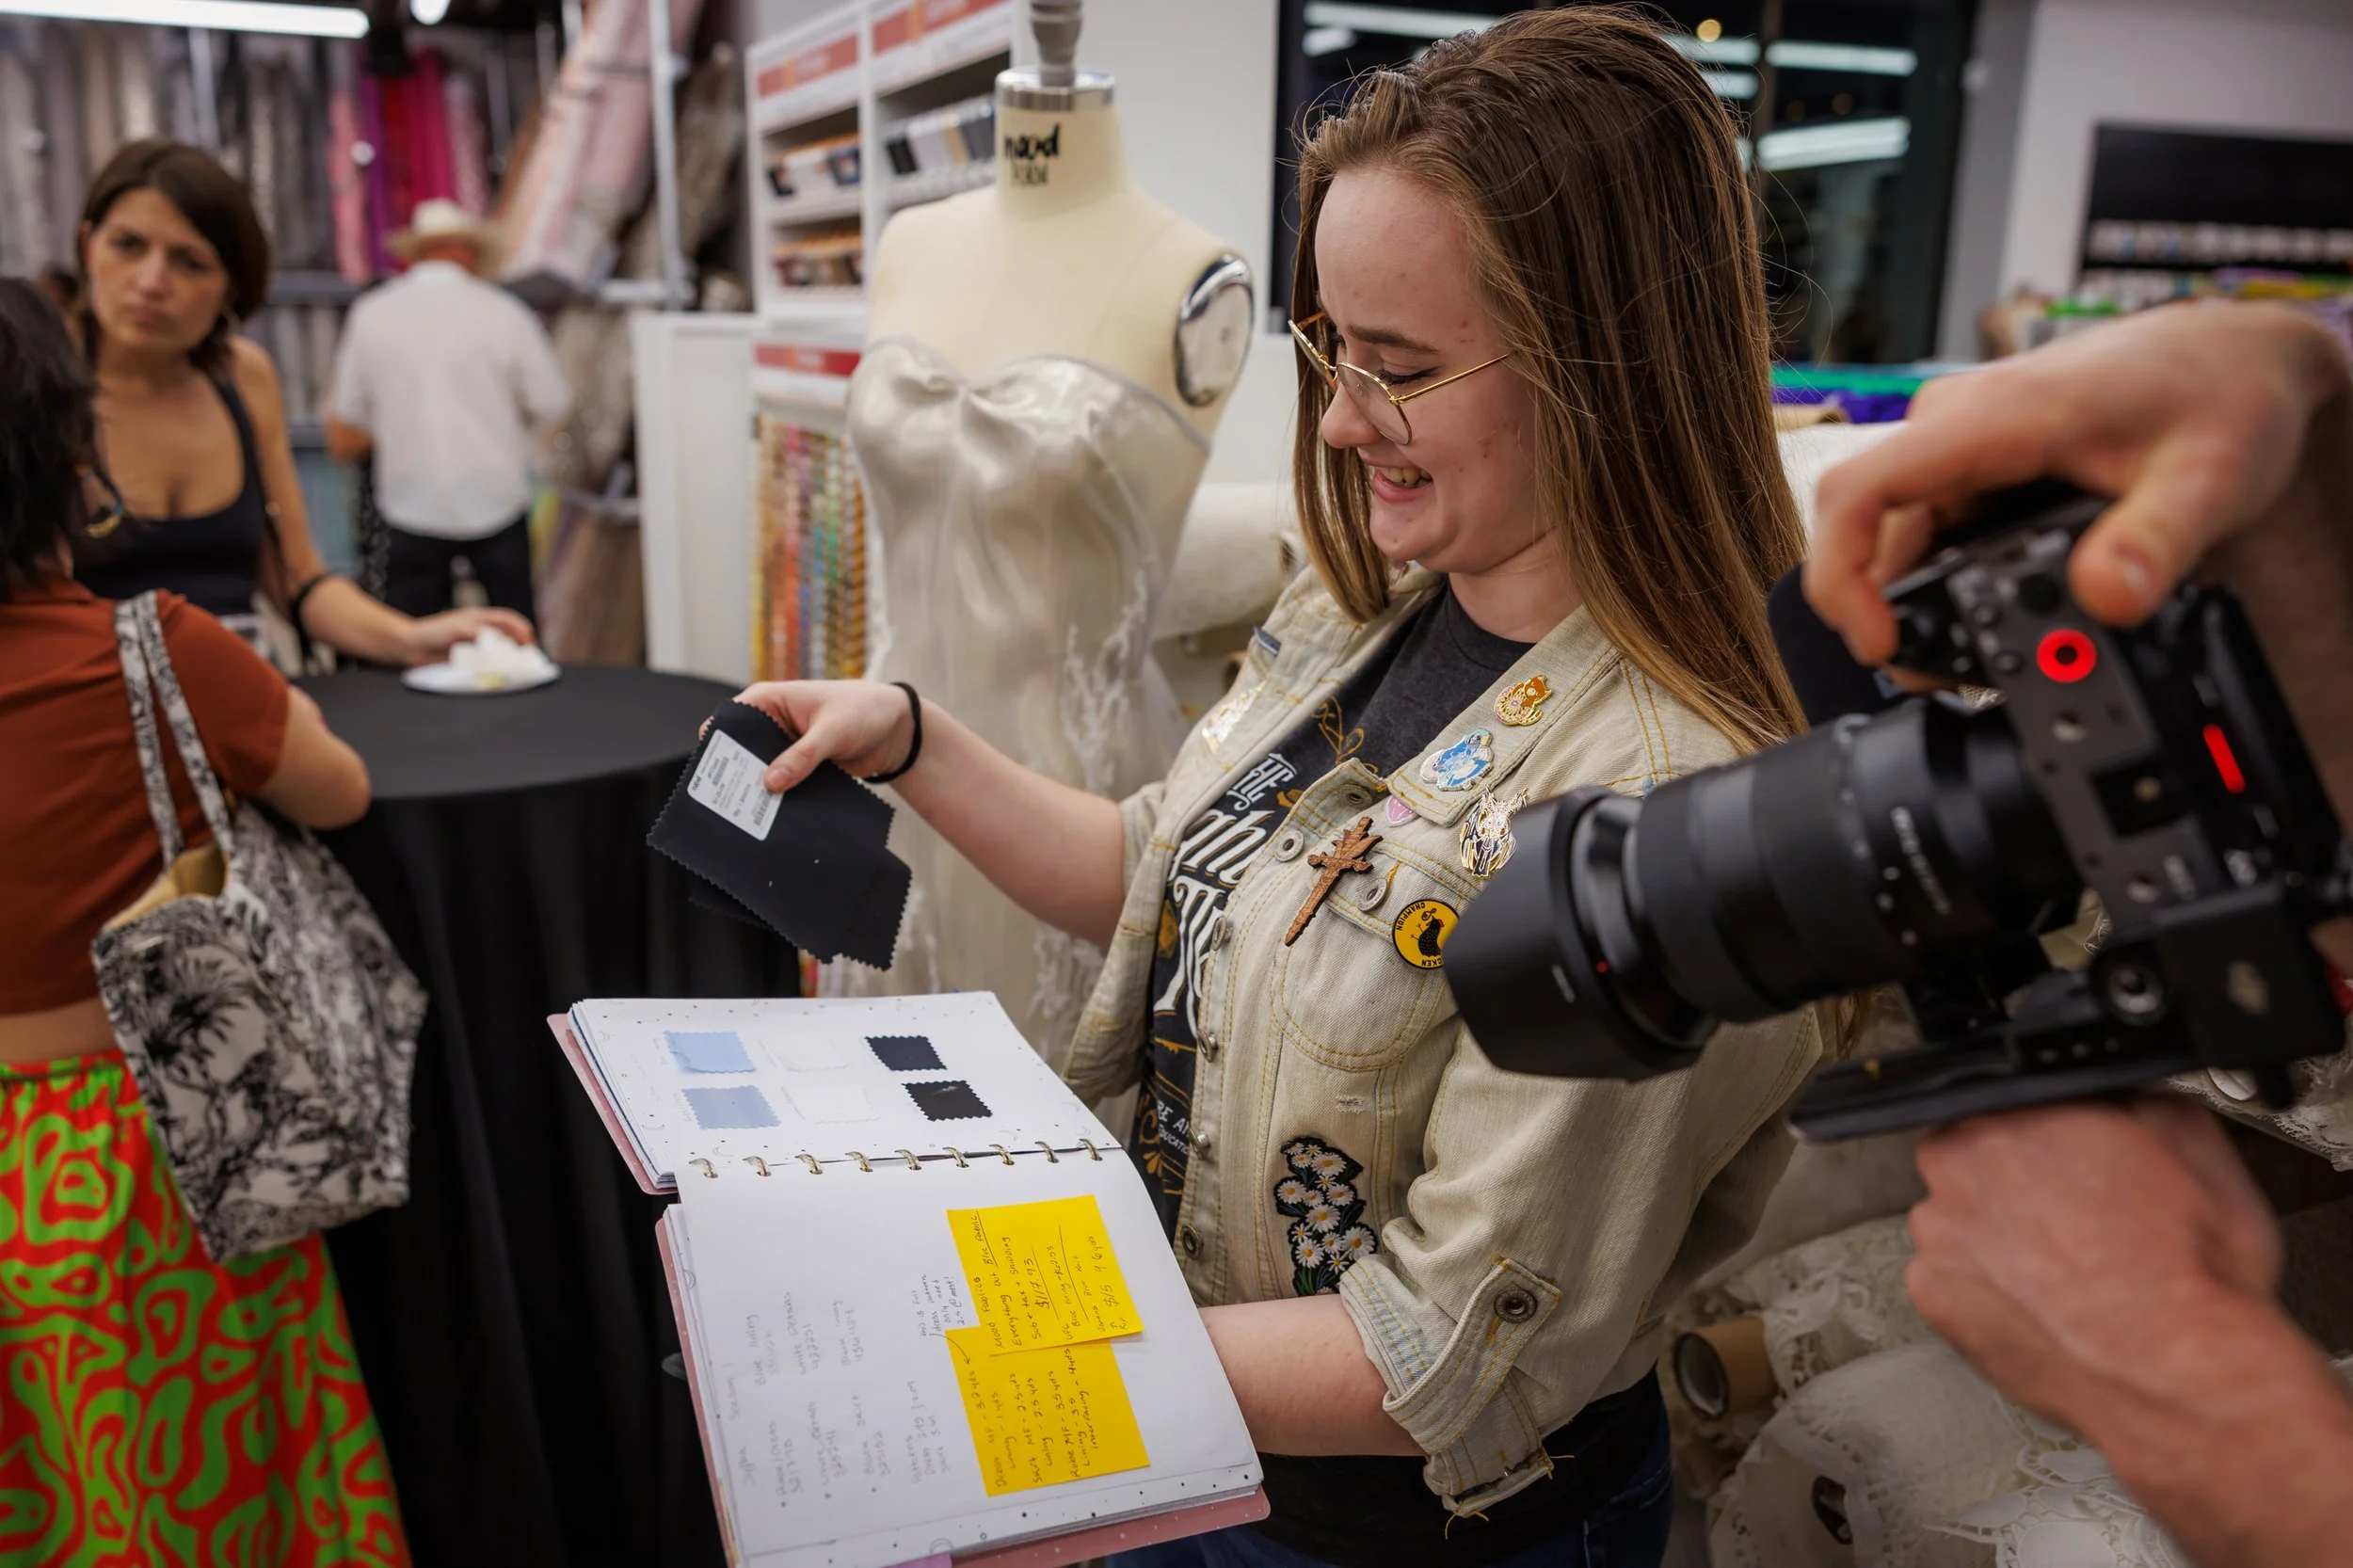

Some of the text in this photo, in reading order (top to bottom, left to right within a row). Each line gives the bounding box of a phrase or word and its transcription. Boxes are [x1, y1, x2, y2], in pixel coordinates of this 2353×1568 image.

[1397, 903, 1426, 931] CHAMPION
[982, 1245, 993, 1265] Blue
[990, 1272, 1001, 1287] but
[1019, 1290, 1030, 1307] tax
[932, 1311, 941, 1332] dress
[941, 1305, 951, 1323] only
[1000, 1294, 1022, 1346] Everything
[1069, 1310, 1080, 1327] Blue
[987, 1322, 1004, 1349] Mood
[1067, 1450, 1080, 1477] Robe
